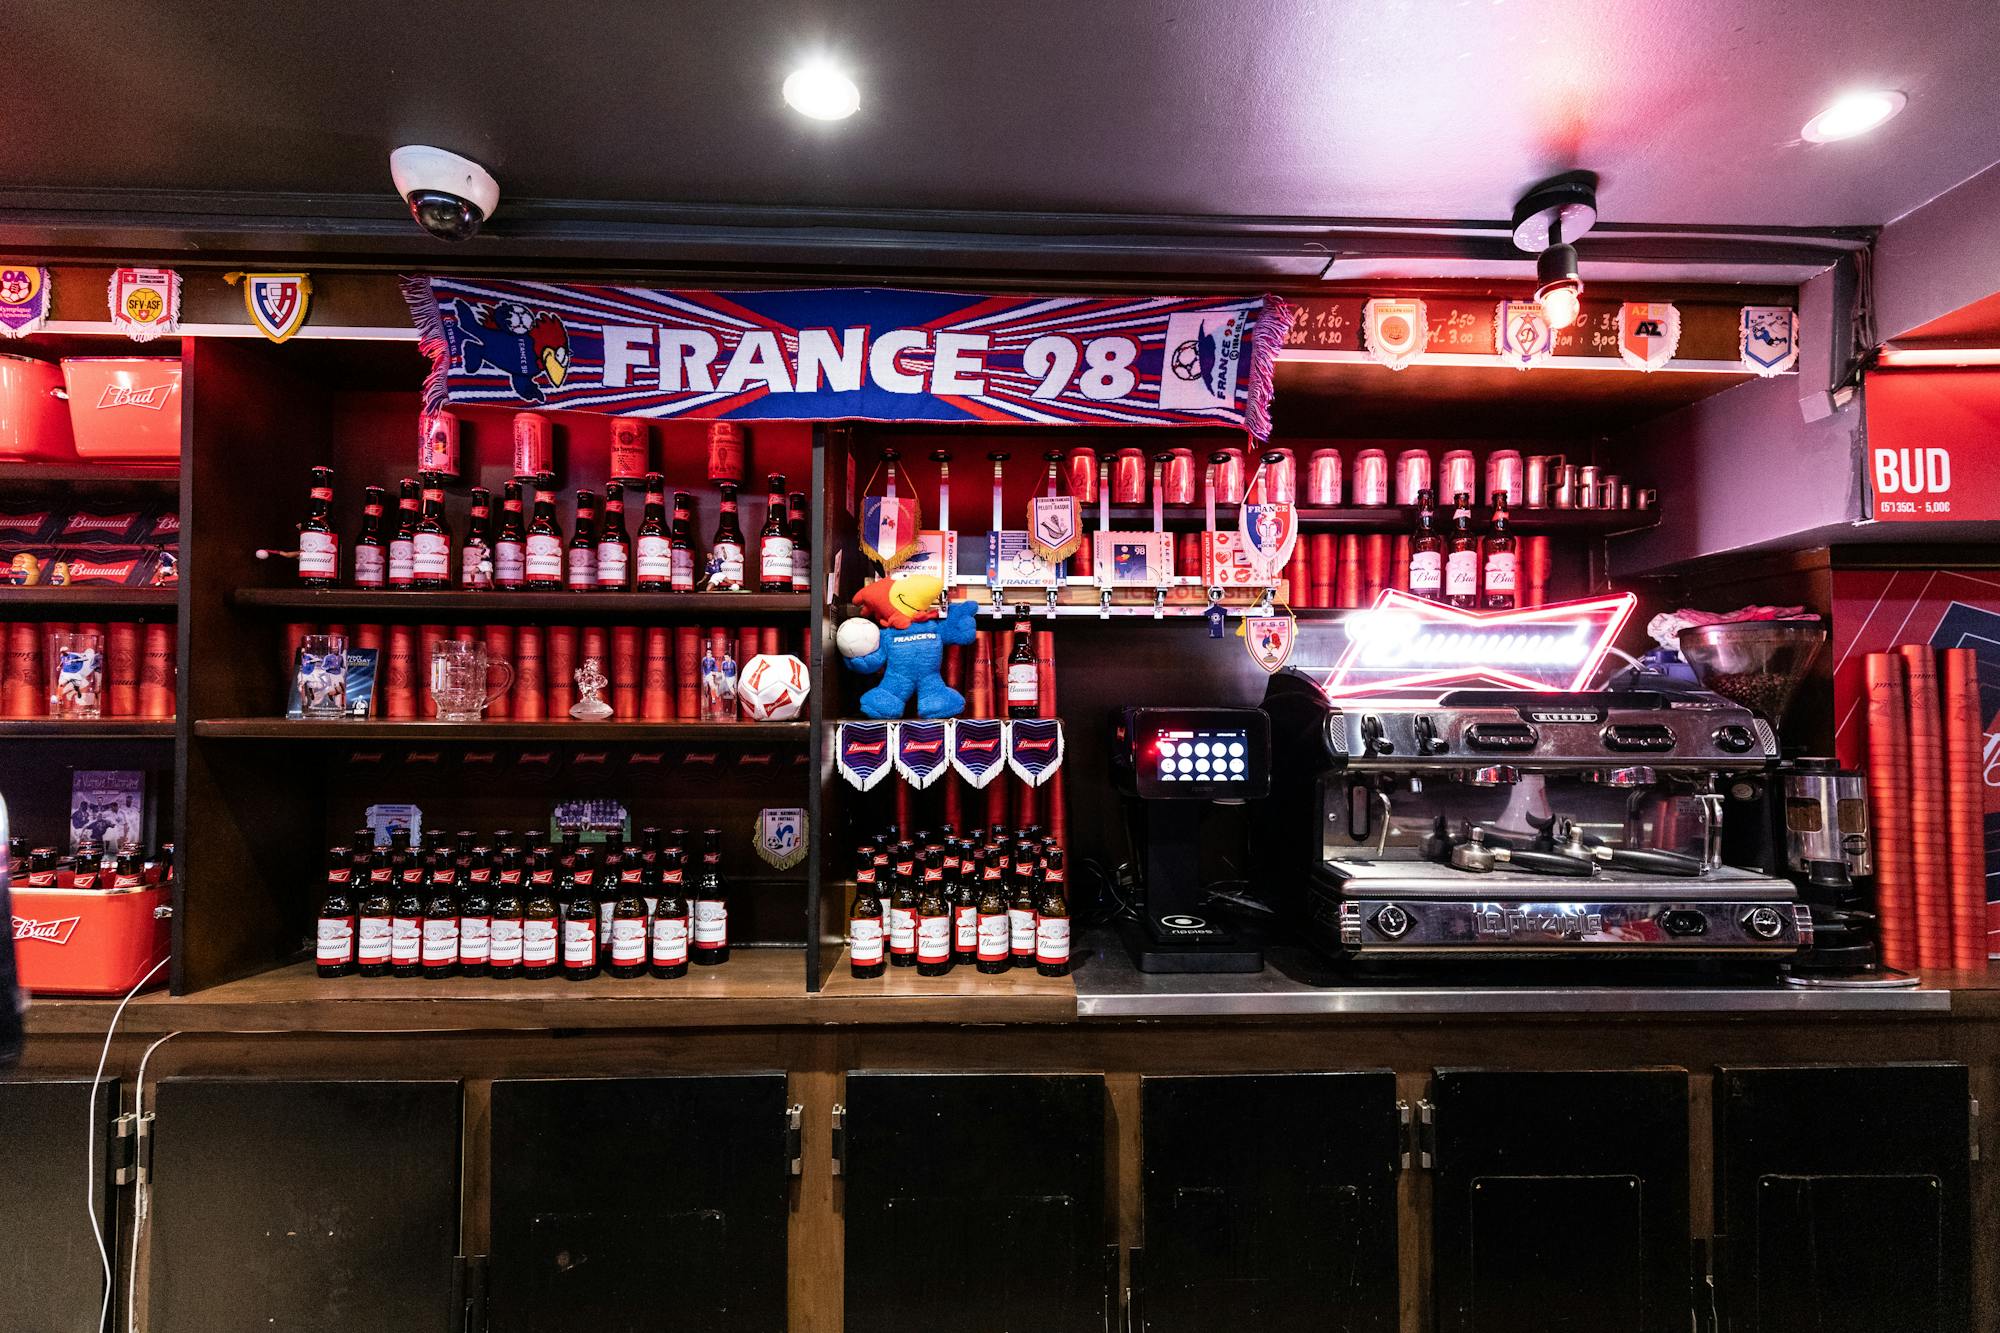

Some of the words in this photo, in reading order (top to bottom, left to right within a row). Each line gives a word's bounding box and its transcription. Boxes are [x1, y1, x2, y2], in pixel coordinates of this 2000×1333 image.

[3, 271, 28, 283] OA
[1632, 306, 1648, 316] AZ
[1634, 321, 1663, 337] AZ
[601, 324, 993, 397] FRANCE
[1022, 332, 1140, 401] 98
[1217, 340, 1231, 399] FRANCE
[1224, 319, 1235, 336] 98
[110, 386, 155, 405] Bud
[1875, 448, 1951, 494] BUD
[1248, 505, 1289, 514] FRANCE
[1896, 501, 1917, 513] 35CL
[1134, 547, 1146, 556] 98
[1415, 571, 1440, 582] Bud
[894, 633, 927, 643] FRANCE
[12, 919, 60, 938] Bud
